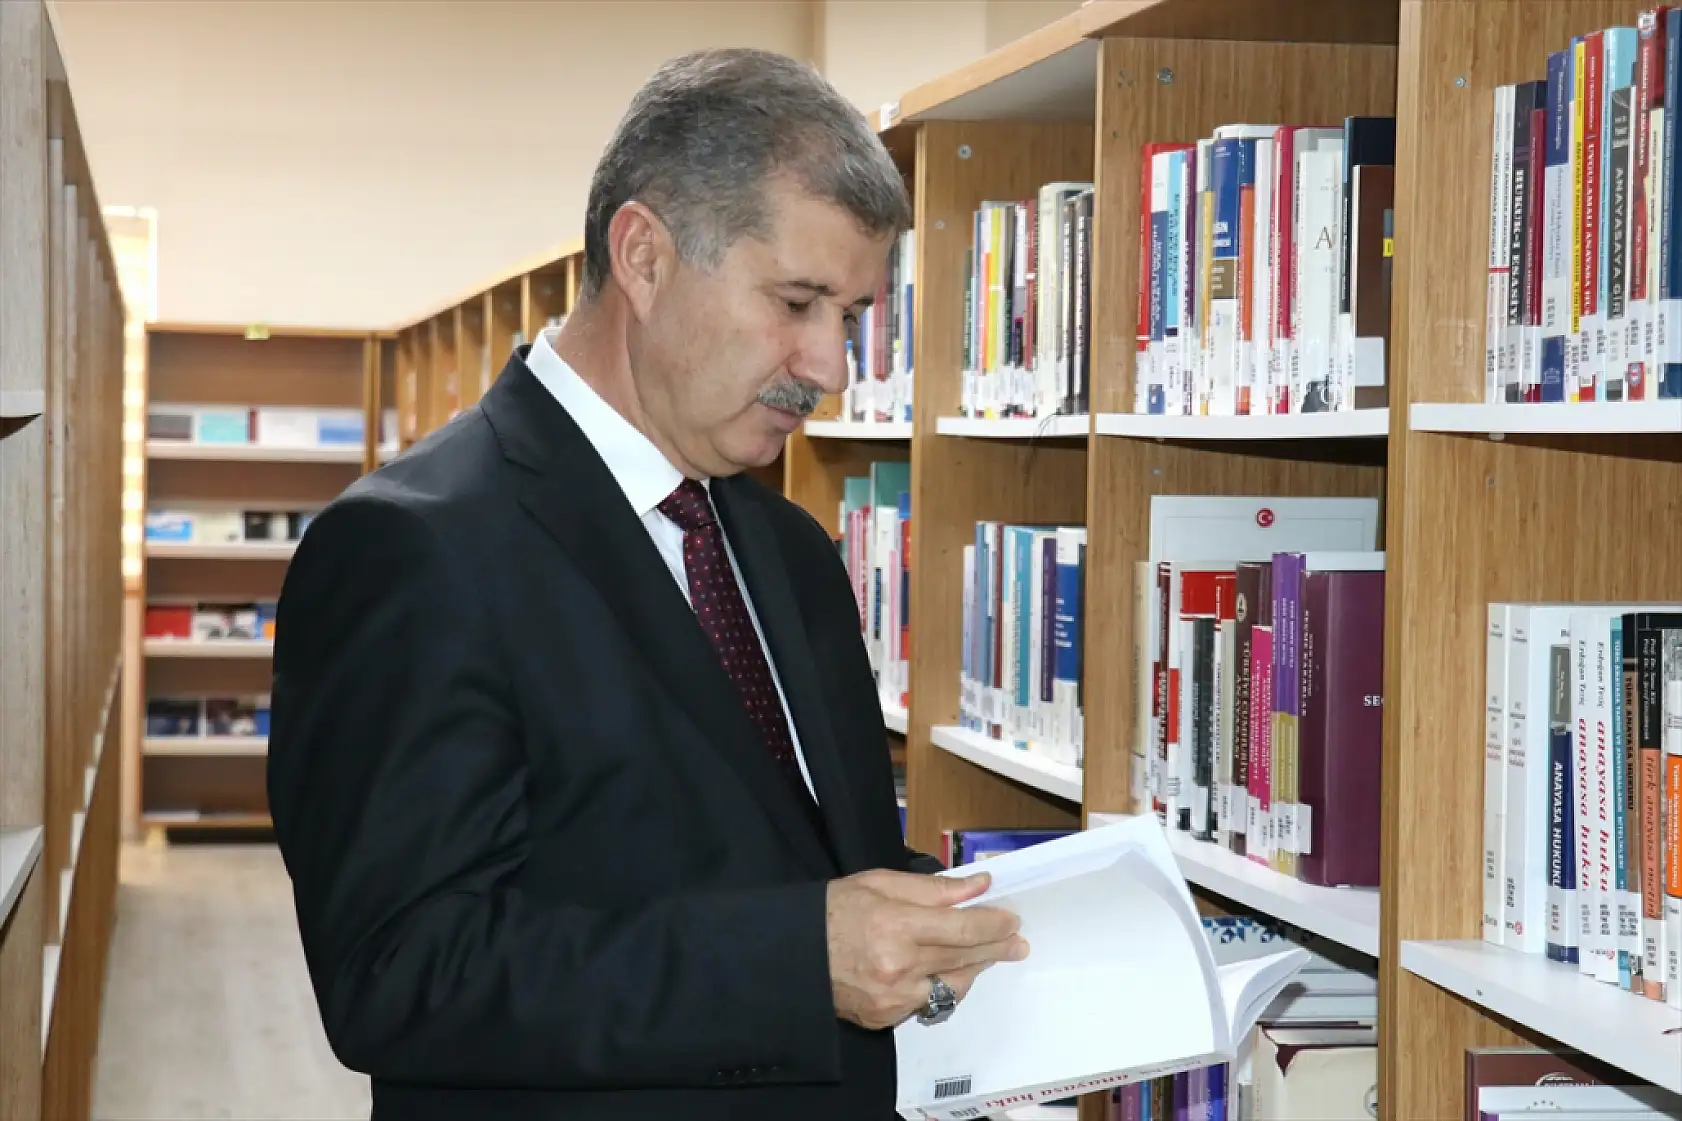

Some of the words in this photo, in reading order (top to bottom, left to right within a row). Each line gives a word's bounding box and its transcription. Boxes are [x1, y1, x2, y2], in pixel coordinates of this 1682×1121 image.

[1613, 168, 1625, 279] ANAYASAYA
[1585, 231, 1593, 287] ANAYASA
[1553, 761, 1563, 824] ANAYASA
[1577, 718, 1589, 817] anayasa
[1595, 721, 1607, 822] anayasa
[1551, 828, 1562, 888] HUKUKU
[1644, 795, 1654, 861] anayasa
